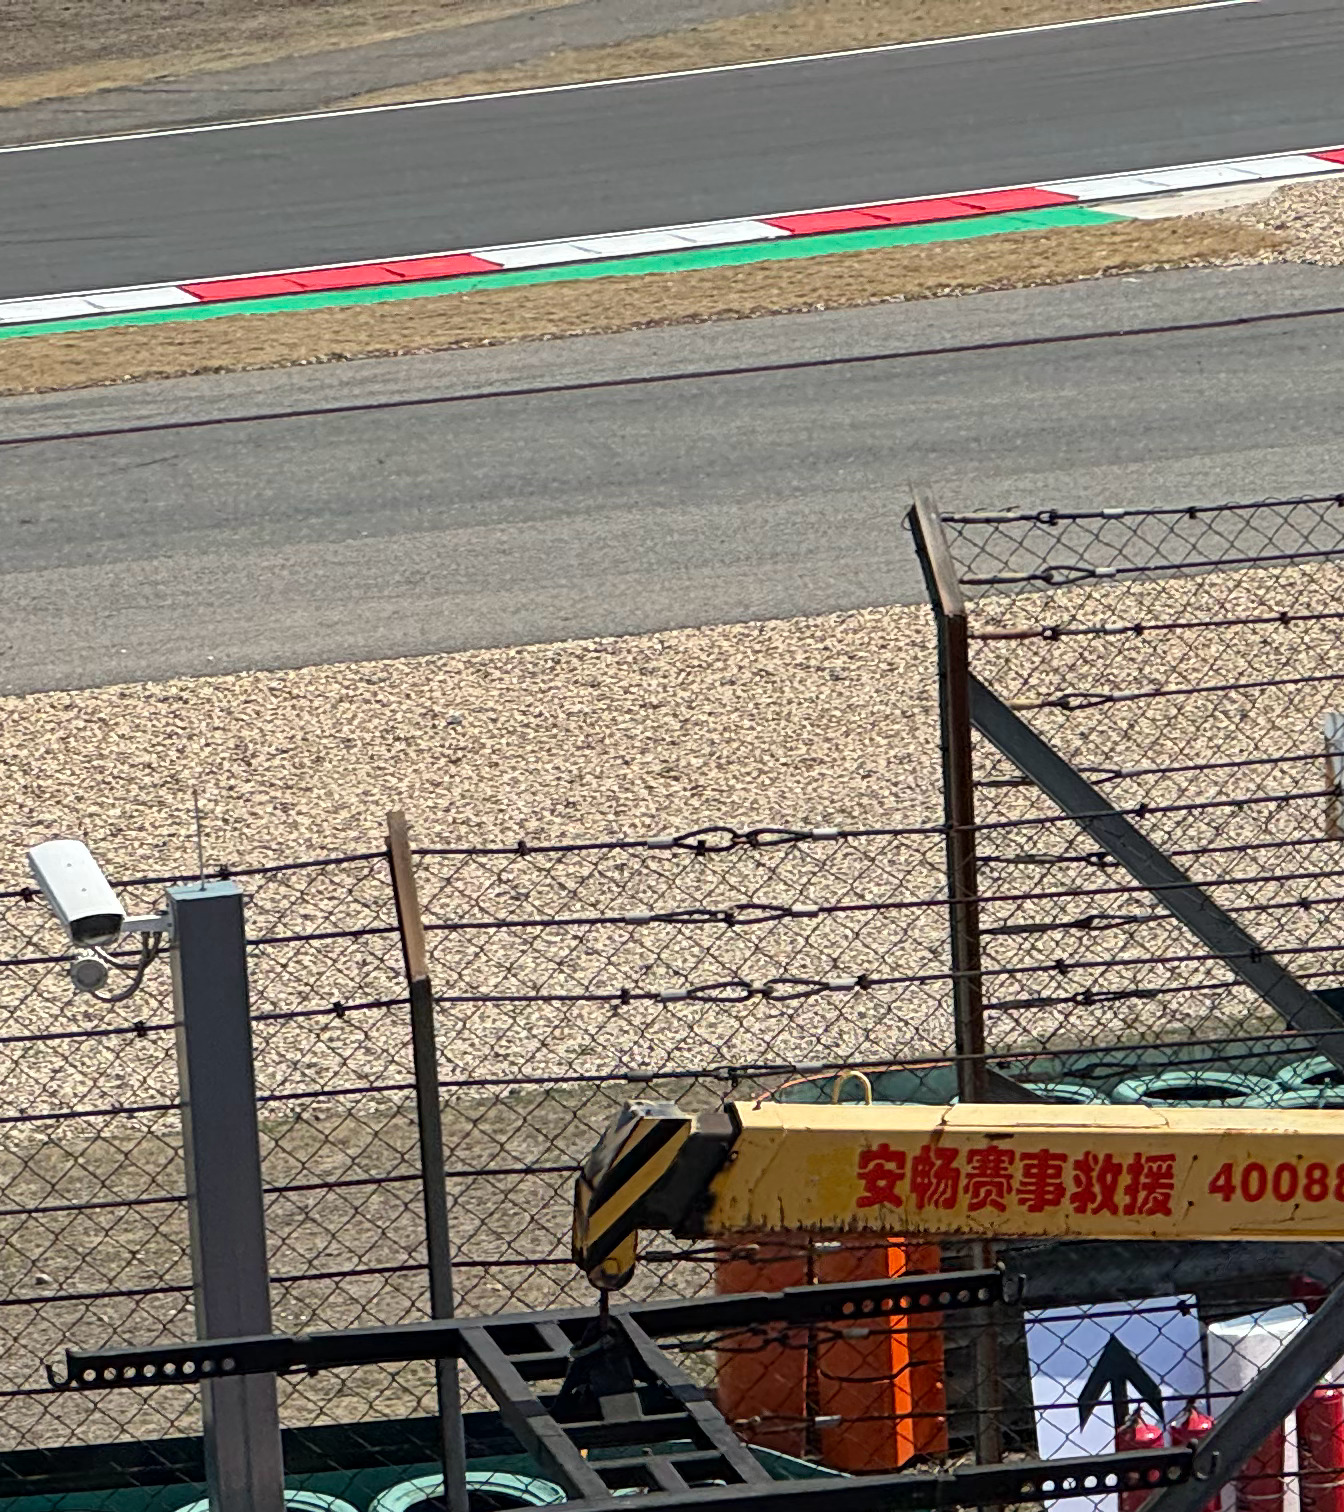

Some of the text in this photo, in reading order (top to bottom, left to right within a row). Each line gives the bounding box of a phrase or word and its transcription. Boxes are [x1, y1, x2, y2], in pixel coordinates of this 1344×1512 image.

[857, 1144, 1177, 1216] 安畅赛事救援
